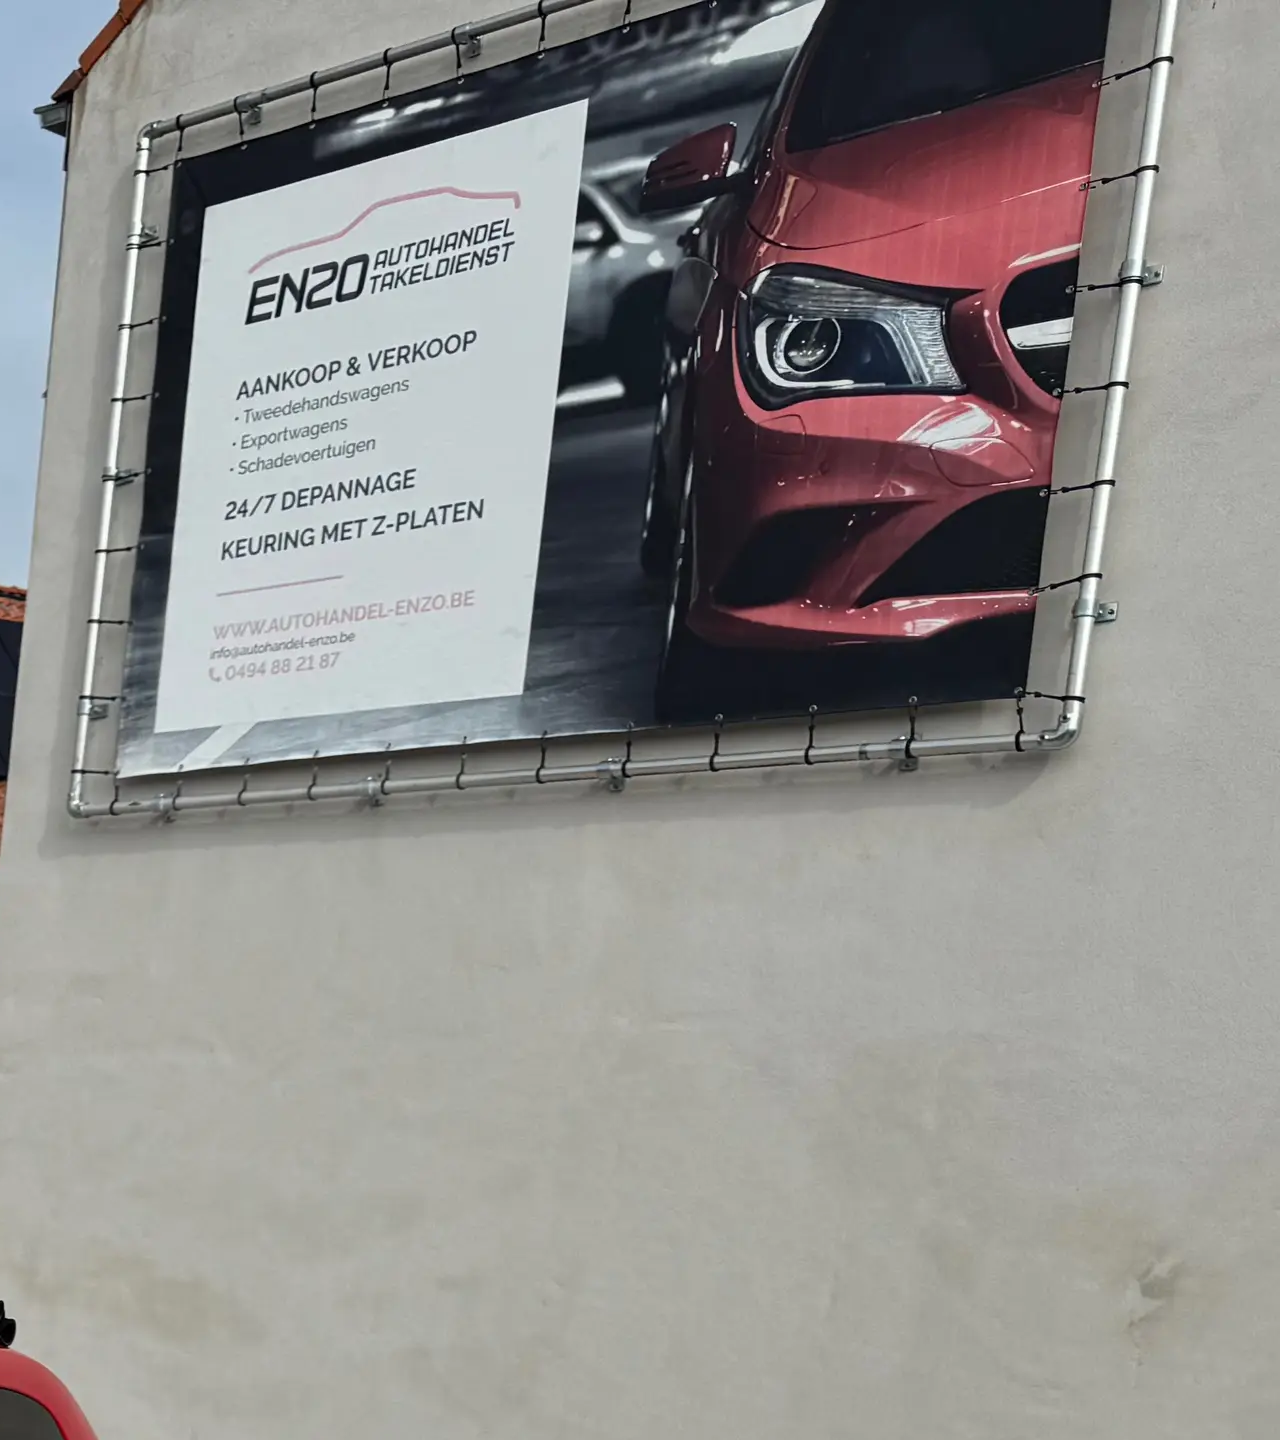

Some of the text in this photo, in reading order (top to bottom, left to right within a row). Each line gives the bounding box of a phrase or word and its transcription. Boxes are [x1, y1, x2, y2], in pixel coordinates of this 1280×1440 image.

[369, 241, 515, 294] TAKELDIENST
[373, 218, 515, 270] AUTOHANDEL
[236, 330, 477, 400] AANKOOP & VERKOOP
[243, 379, 410, 423] Tweedehandswagens
[237, 437, 376, 475] Schadevoertuigen
[241, 417, 348, 449] Exportwagens
[224, 468, 417, 521] 24/7 DEPANNAGE
[221, 498, 485, 560] KEURING MET Z-PLATEN
[213, 590, 475, 640] WWW.AUTOHANDEL-ENZO.BE
[209, 632, 356, 659] info@autohandel-enzo.be
[225, 652, 340, 681] 0494 88 21 87
